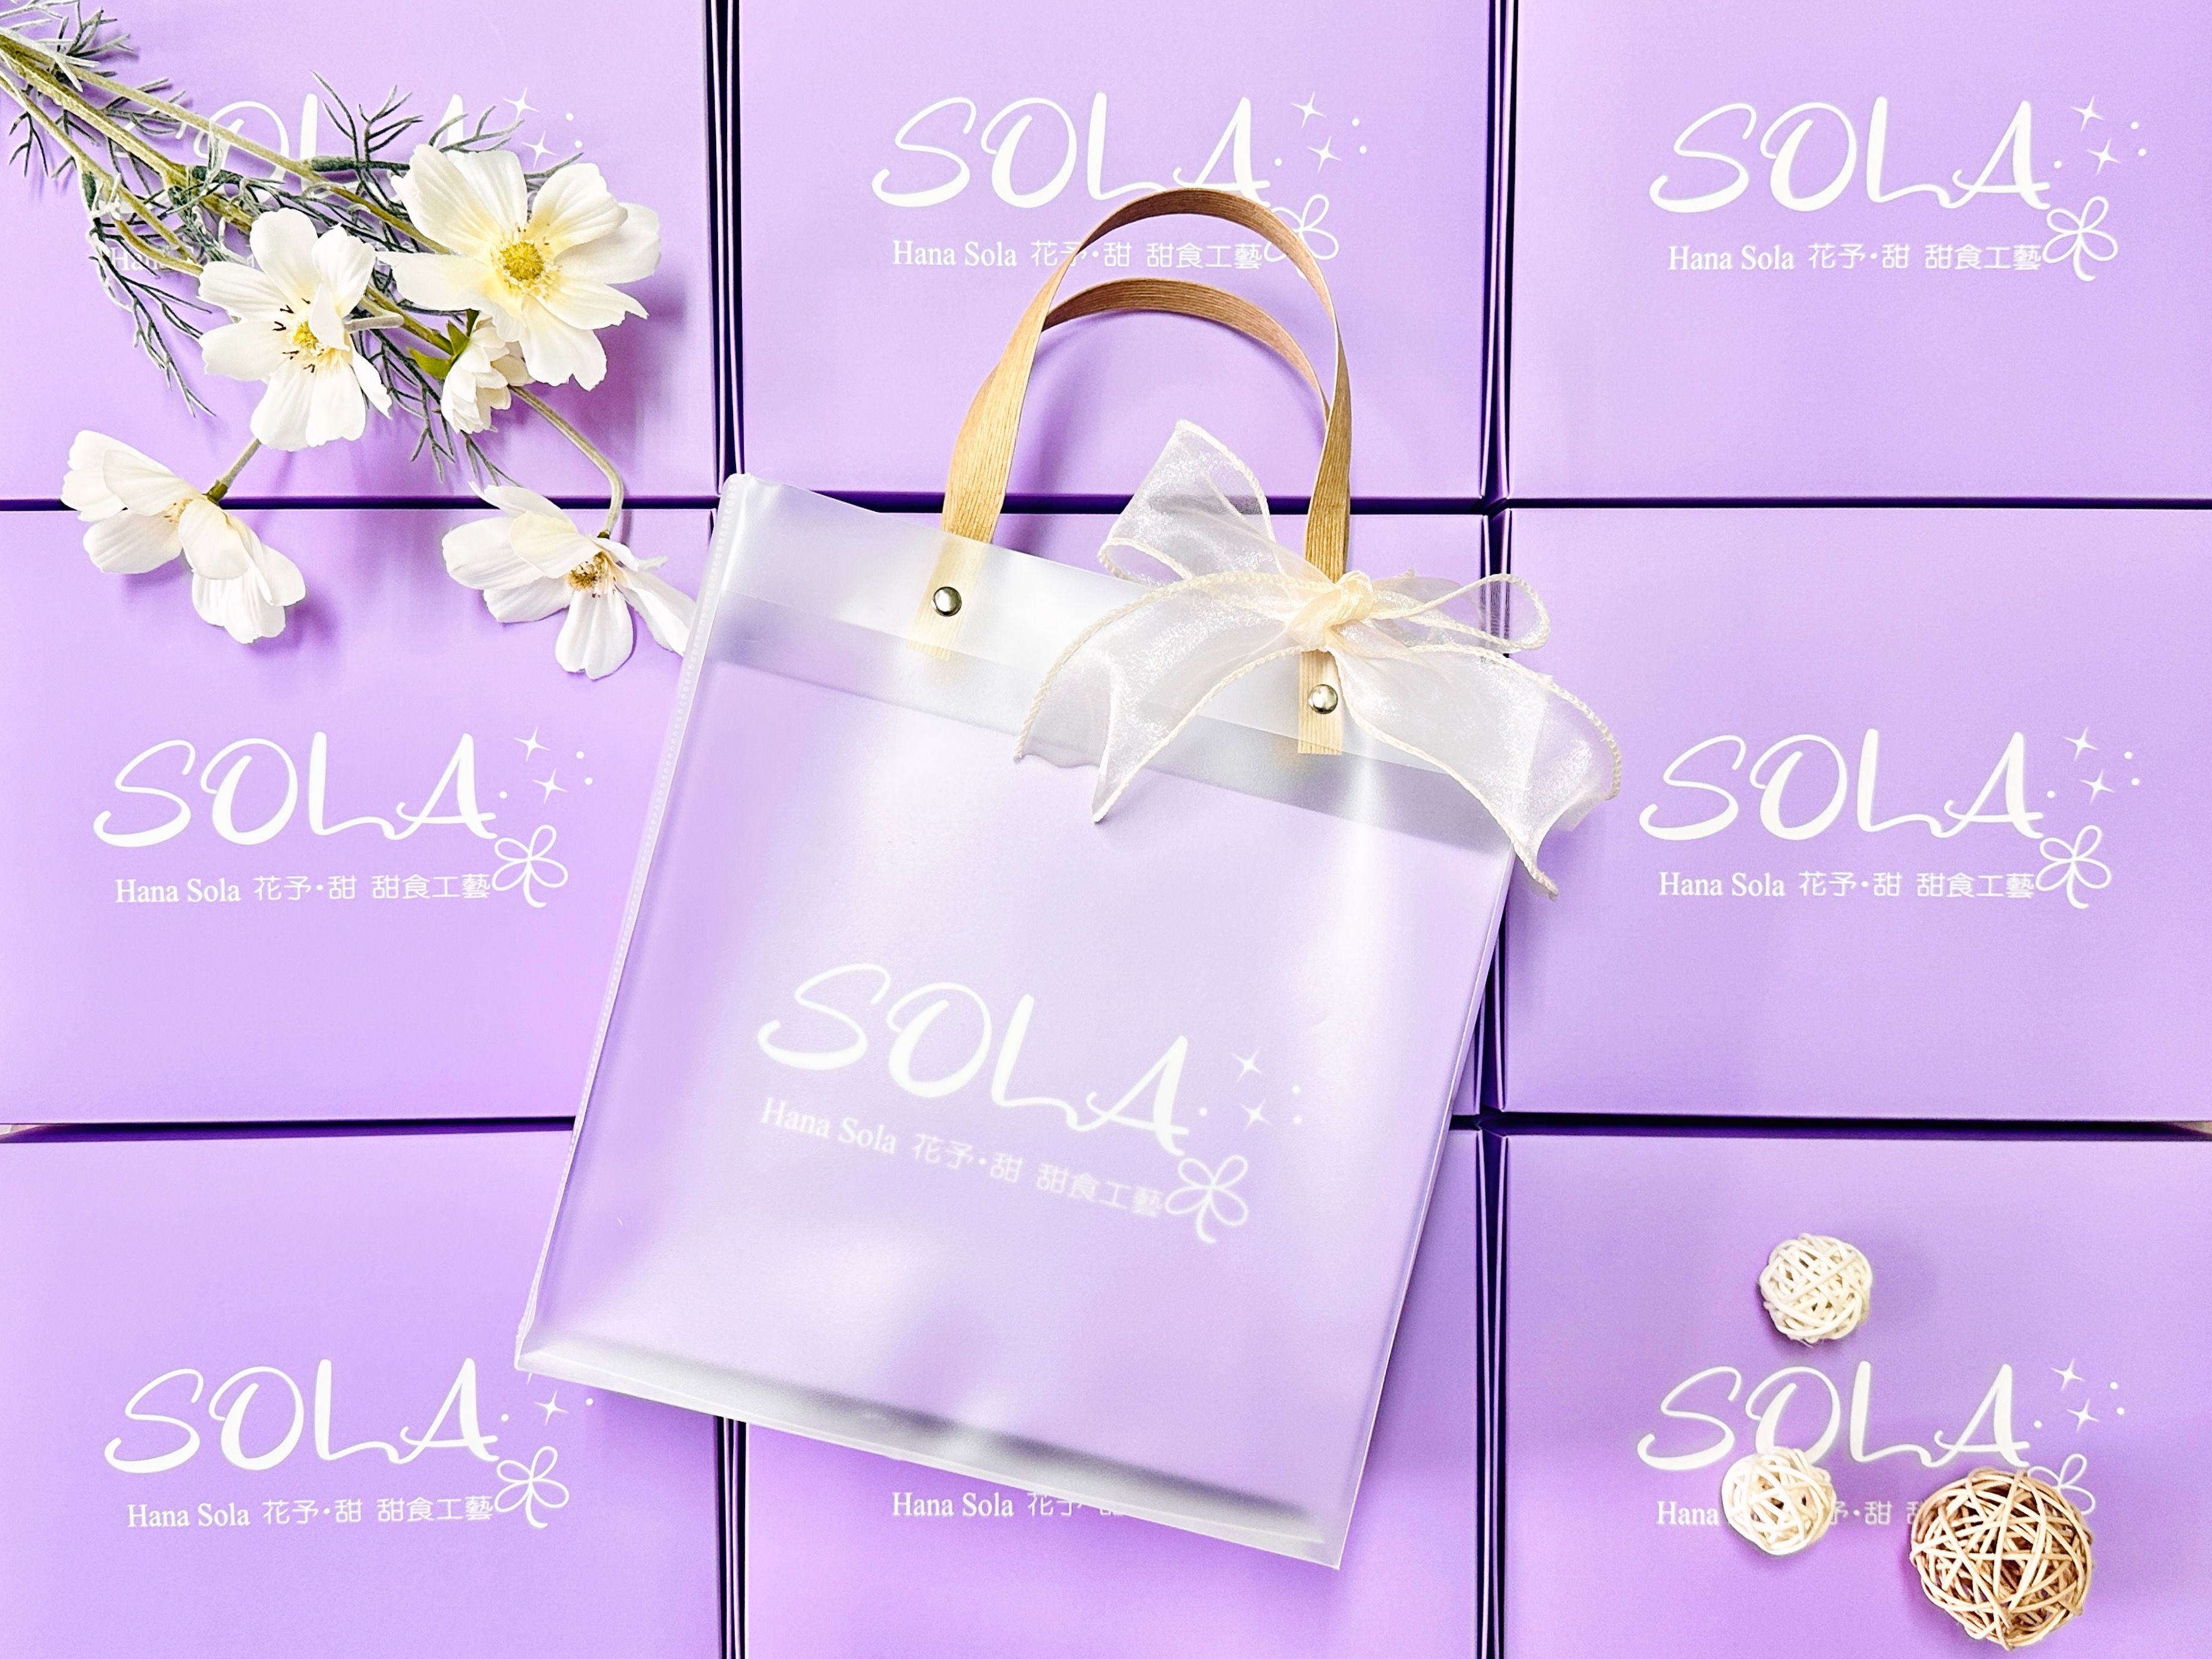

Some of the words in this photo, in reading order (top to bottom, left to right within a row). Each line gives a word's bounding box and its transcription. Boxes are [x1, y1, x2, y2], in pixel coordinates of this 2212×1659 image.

[872, 93, 1270, 208] SOLA
[1650, 96, 2051, 213] SOLA
[893, 240, 956, 266] Hana
[965, 242, 1017, 266] Sola
[1147, 242, 1262, 269] 甜食工藝
[1669, 246, 1732, 270] Hana
[1741, 245, 1794, 270] Sola
[1925, 243, 2041, 270] 甜食工藝
[93, 731, 498, 847] SOLA
[1639, 728, 2043, 840] SOLA
[115, 878, 179, 903] Hana
[187, 878, 241, 903] Sola
[371, 873, 490, 900] 甜食工藝
[1659, 872, 1723, 896] Hana
[1731, 872, 1785, 897] Sola
[1916, 872, 2034, 899] 甜食工藝
[757, 963, 1189, 1156] SOLA
[760, 1097, 830, 1139] Hana
[838, 1116, 897, 1154] Sola
[105, 1357, 499, 1473] SOLA
[1638, 1361, 2030, 1470] SOLA
[127, 1503, 190, 1528] Hana
[198, 1502, 250, 1527] Sola
[377, 1495, 493, 1523] 甜食工藝
[892, 1492, 954, 1517] Hana
[962, 1492, 1014, 1517] Sola
[1657, 1500, 1719, 1526] Hana
